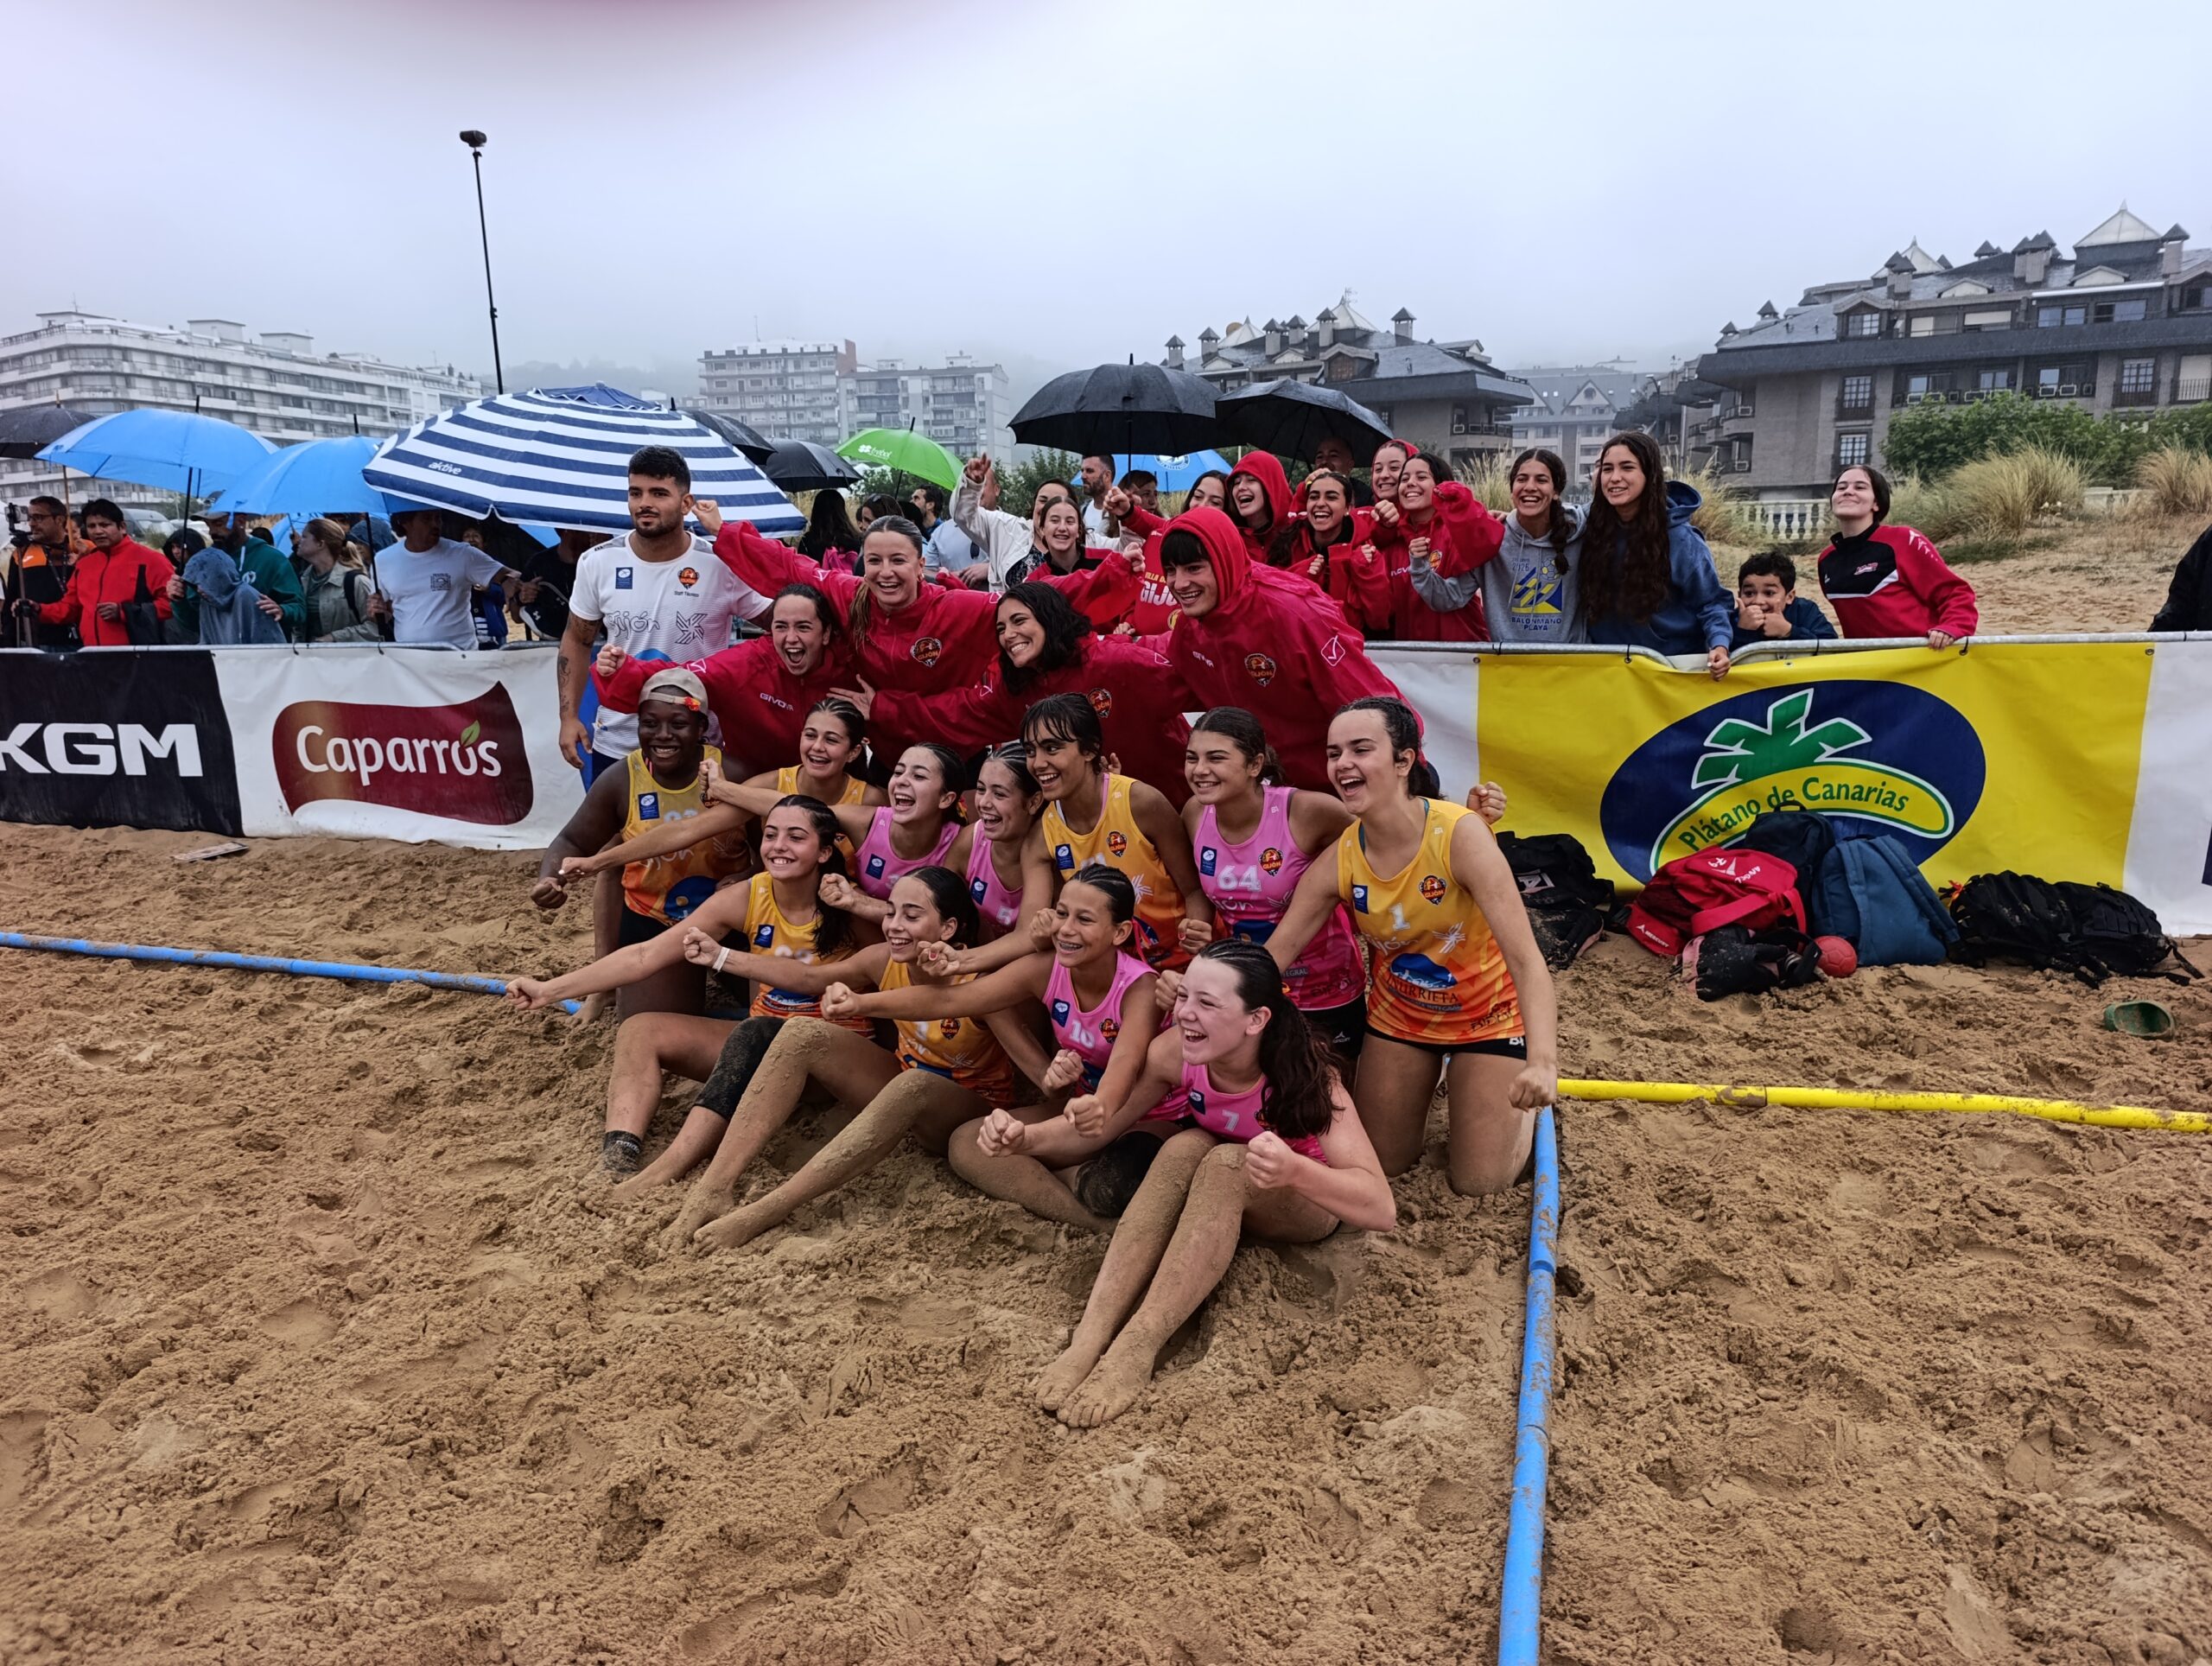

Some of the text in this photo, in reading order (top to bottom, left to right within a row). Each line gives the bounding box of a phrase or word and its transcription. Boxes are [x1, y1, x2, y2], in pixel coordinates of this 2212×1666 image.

[428, 461, 462, 474] aktive
[0, 722, 204, 778] KGM
[1678, 776, 1910, 851] Plátano de Canarias
[1217, 865, 1262, 893] 64
[995, 905, 1014, 926] 5
[1389, 902, 1411, 931] 1
[1070, 1019, 1096, 1049] 10
[1222, 1109, 1240, 1133] 7
